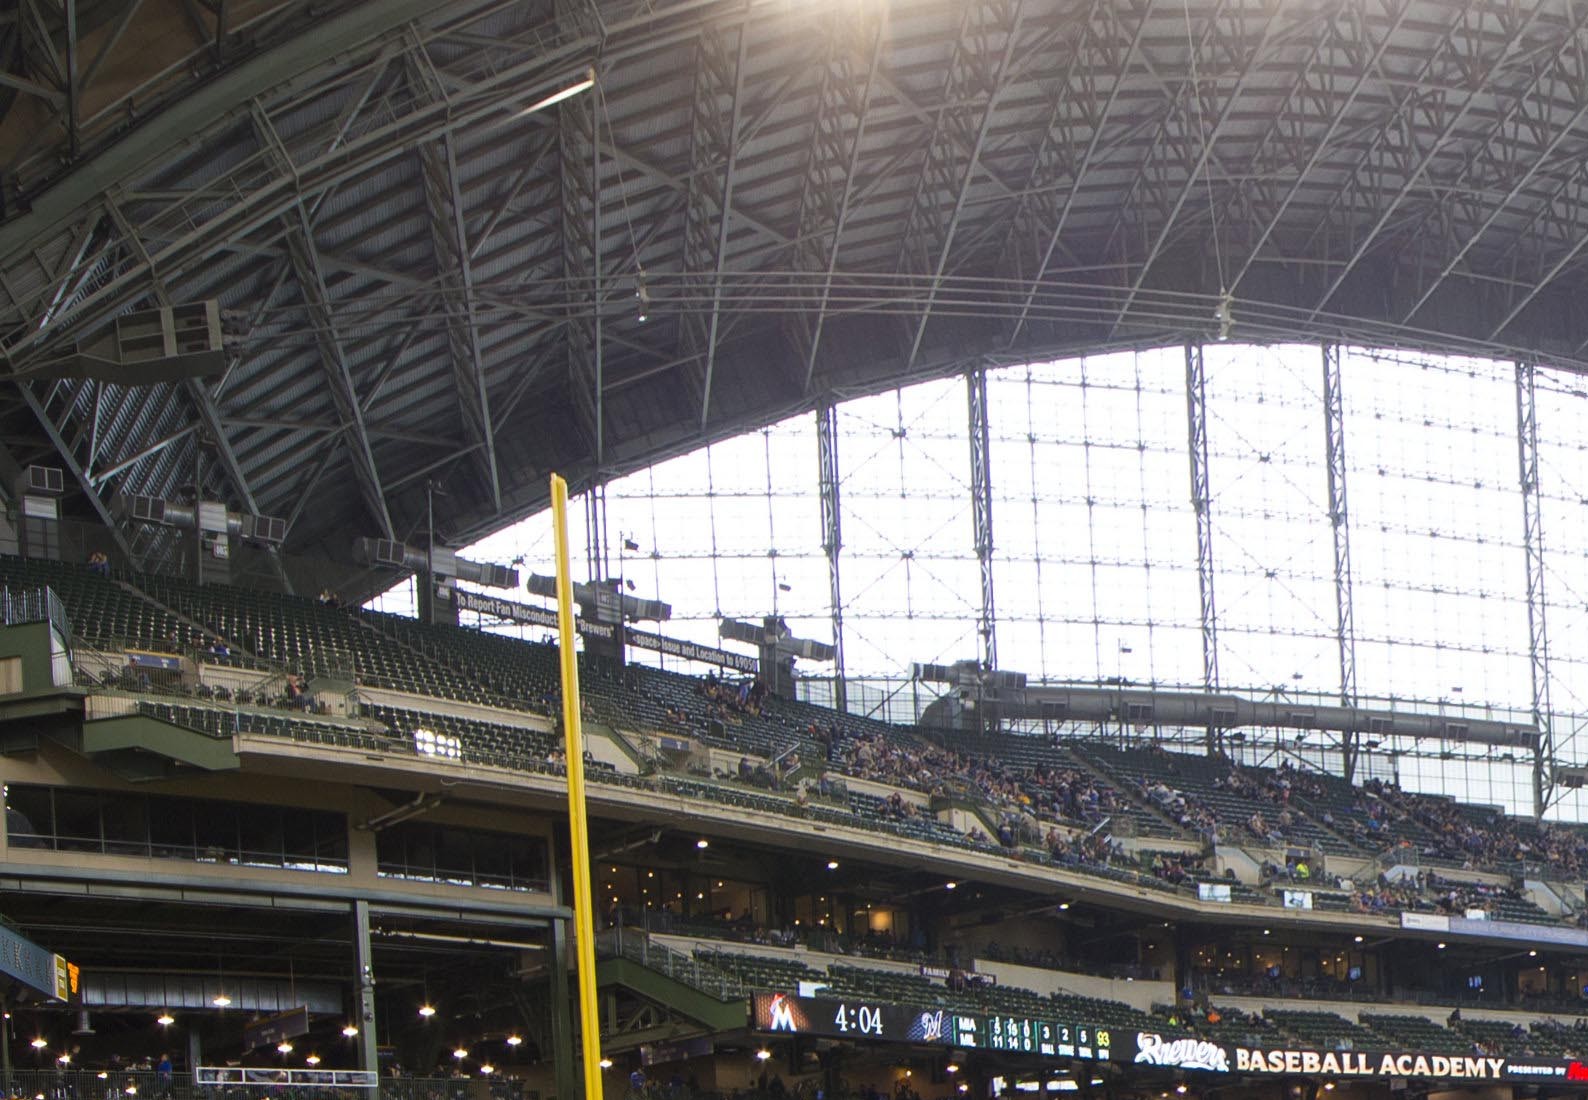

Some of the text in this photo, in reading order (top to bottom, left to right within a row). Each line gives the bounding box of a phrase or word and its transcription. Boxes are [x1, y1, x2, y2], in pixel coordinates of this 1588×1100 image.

[467, 594, 495, 615] Report
[496, 602, 511, 617] Fan
[512, 605, 558, 627] Misconduct
[835, 1004, 883, 1035] 4:04
[1097, 1031, 1110, 1047] 93
[1236, 1049, 1374, 1075] BASEBALL
[1379, 1054, 1505, 1079] ACADEMY
